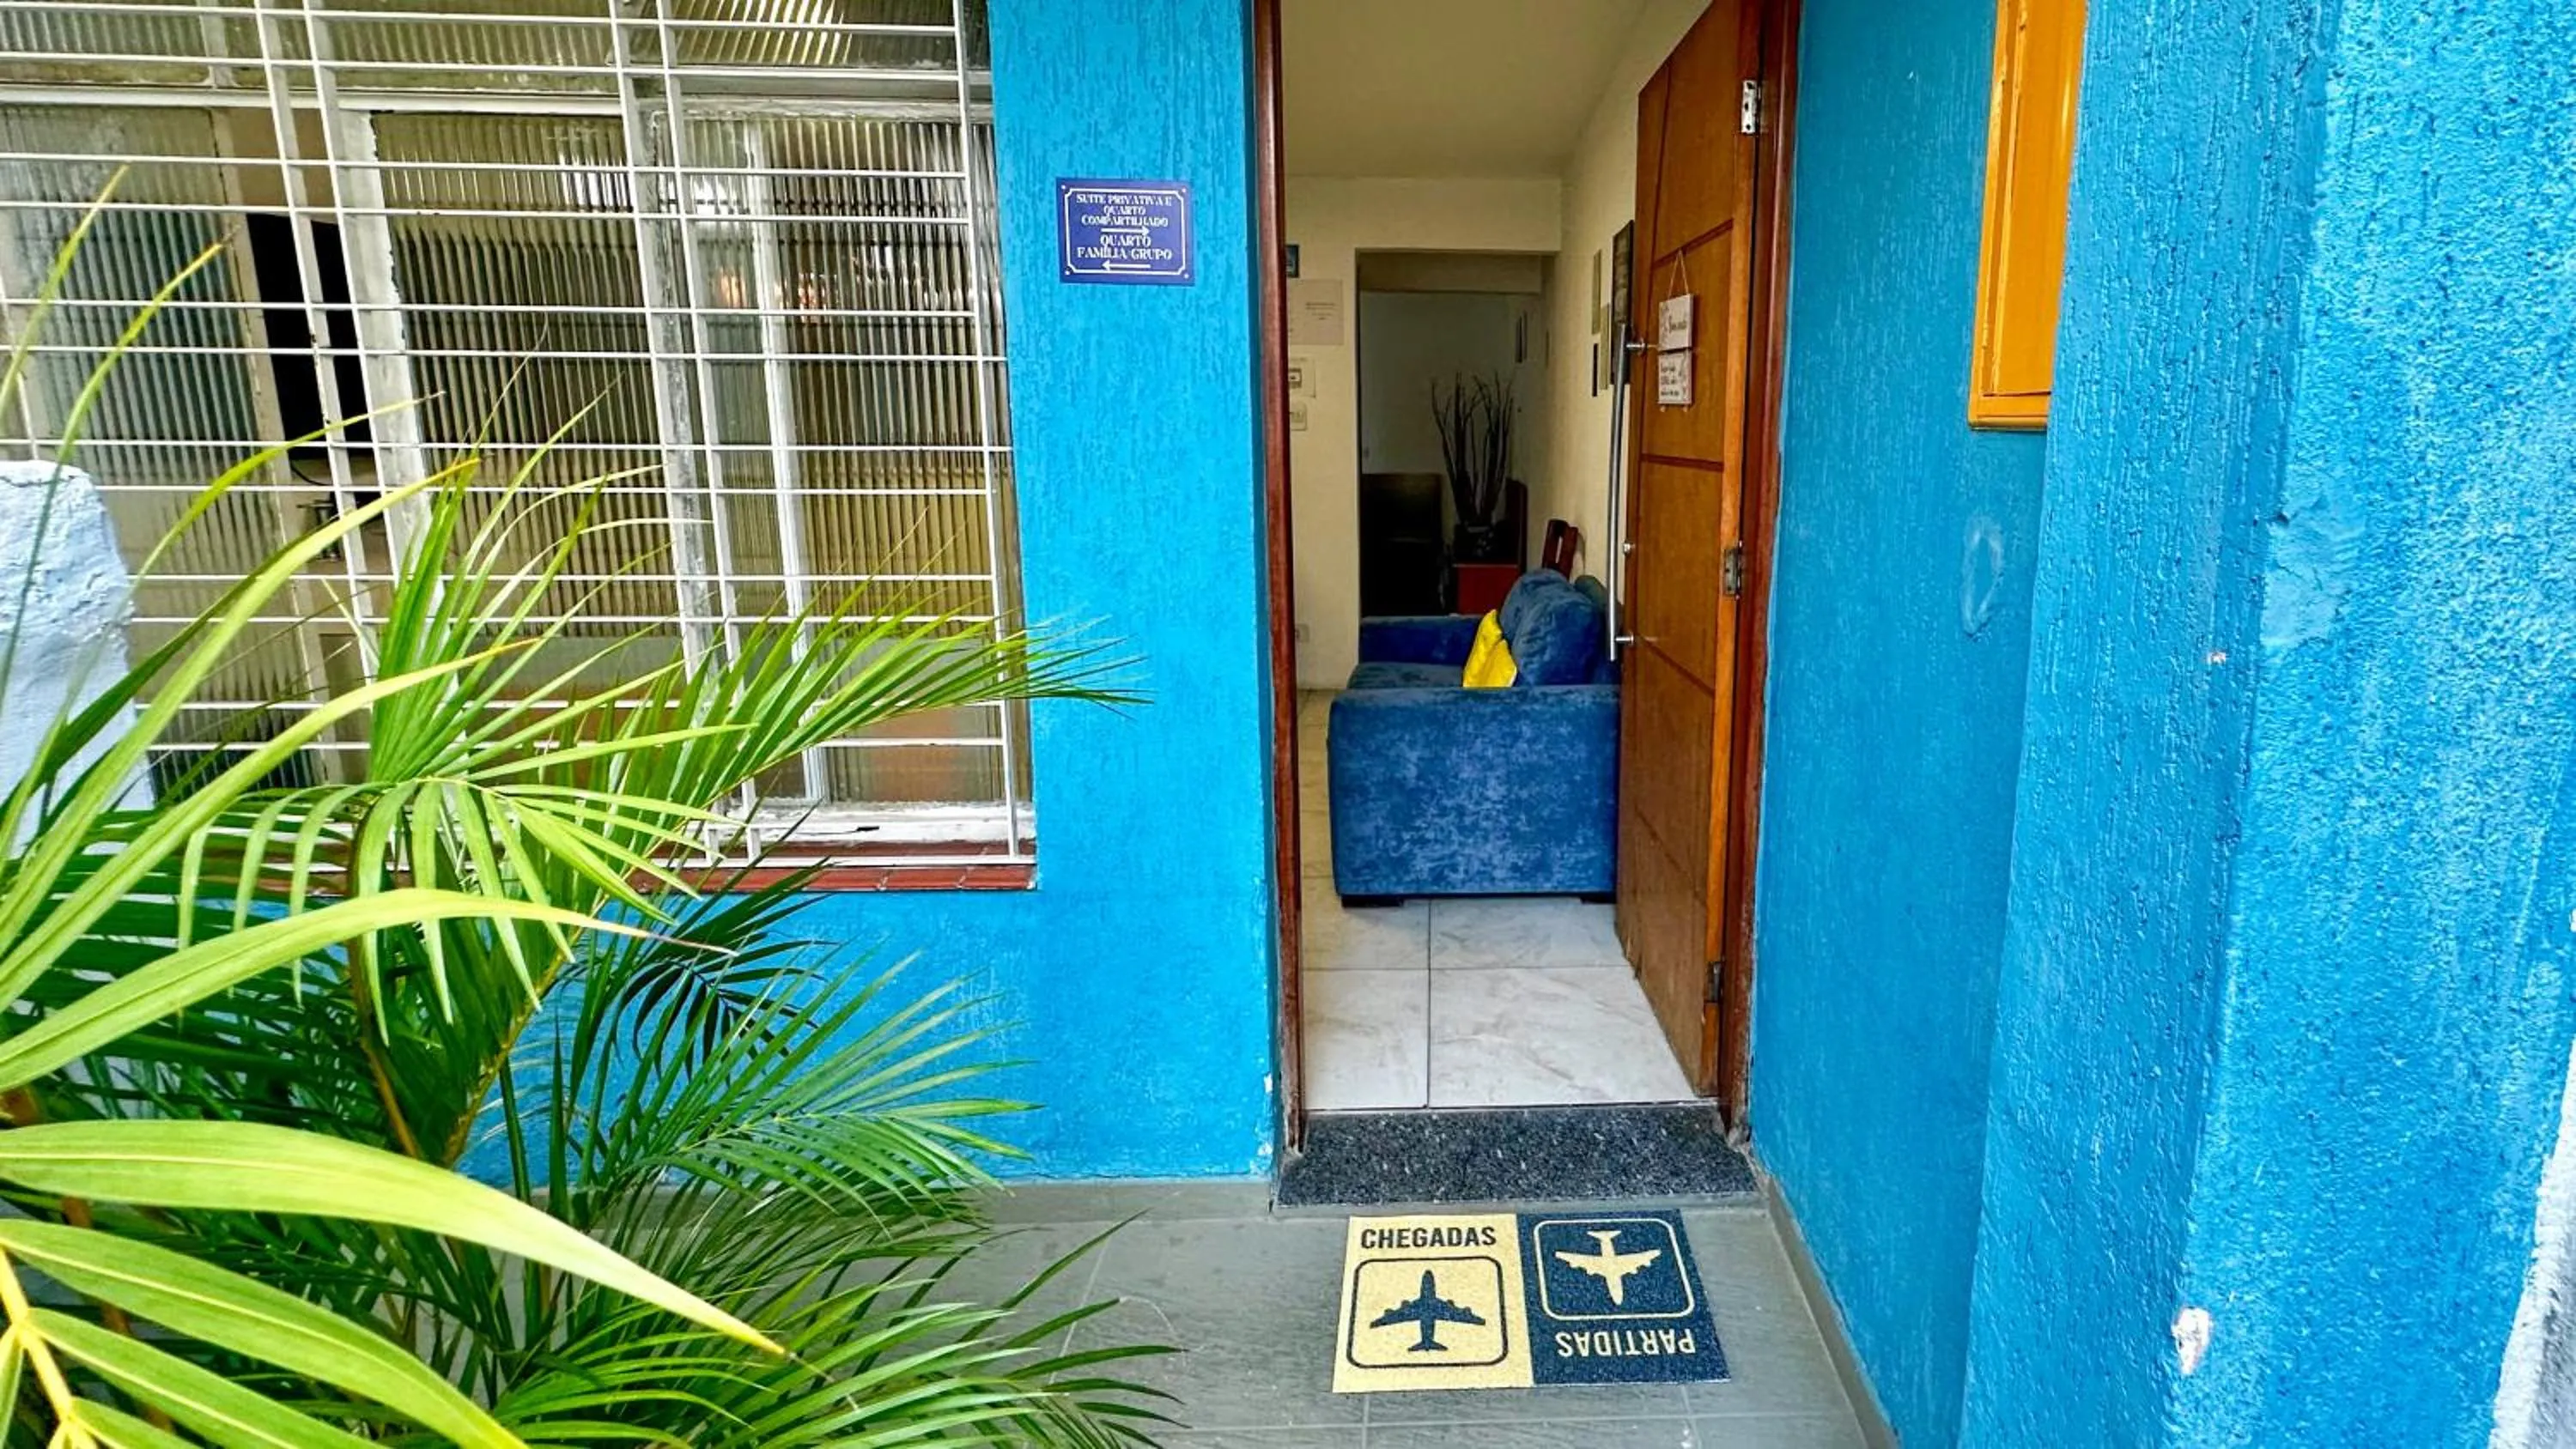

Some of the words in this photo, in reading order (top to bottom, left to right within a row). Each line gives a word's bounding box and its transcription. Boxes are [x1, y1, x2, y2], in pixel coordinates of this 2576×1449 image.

[1077, 194, 1106, 204] SUITE
[1108, 195, 1163, 206] PRIVATIVA
[1165, 196, 1172, 206] E
[1103, 205, 1146, 216] QUARTO
[1081, 215, 1169, 227] COMPARTILHADO
[1100, 234, 1151, 248] QUARTO
[1361, 1226, 1497, 1249] CHEGADAS
[1555, 1329, 1696, 1357] PARTIDAS
